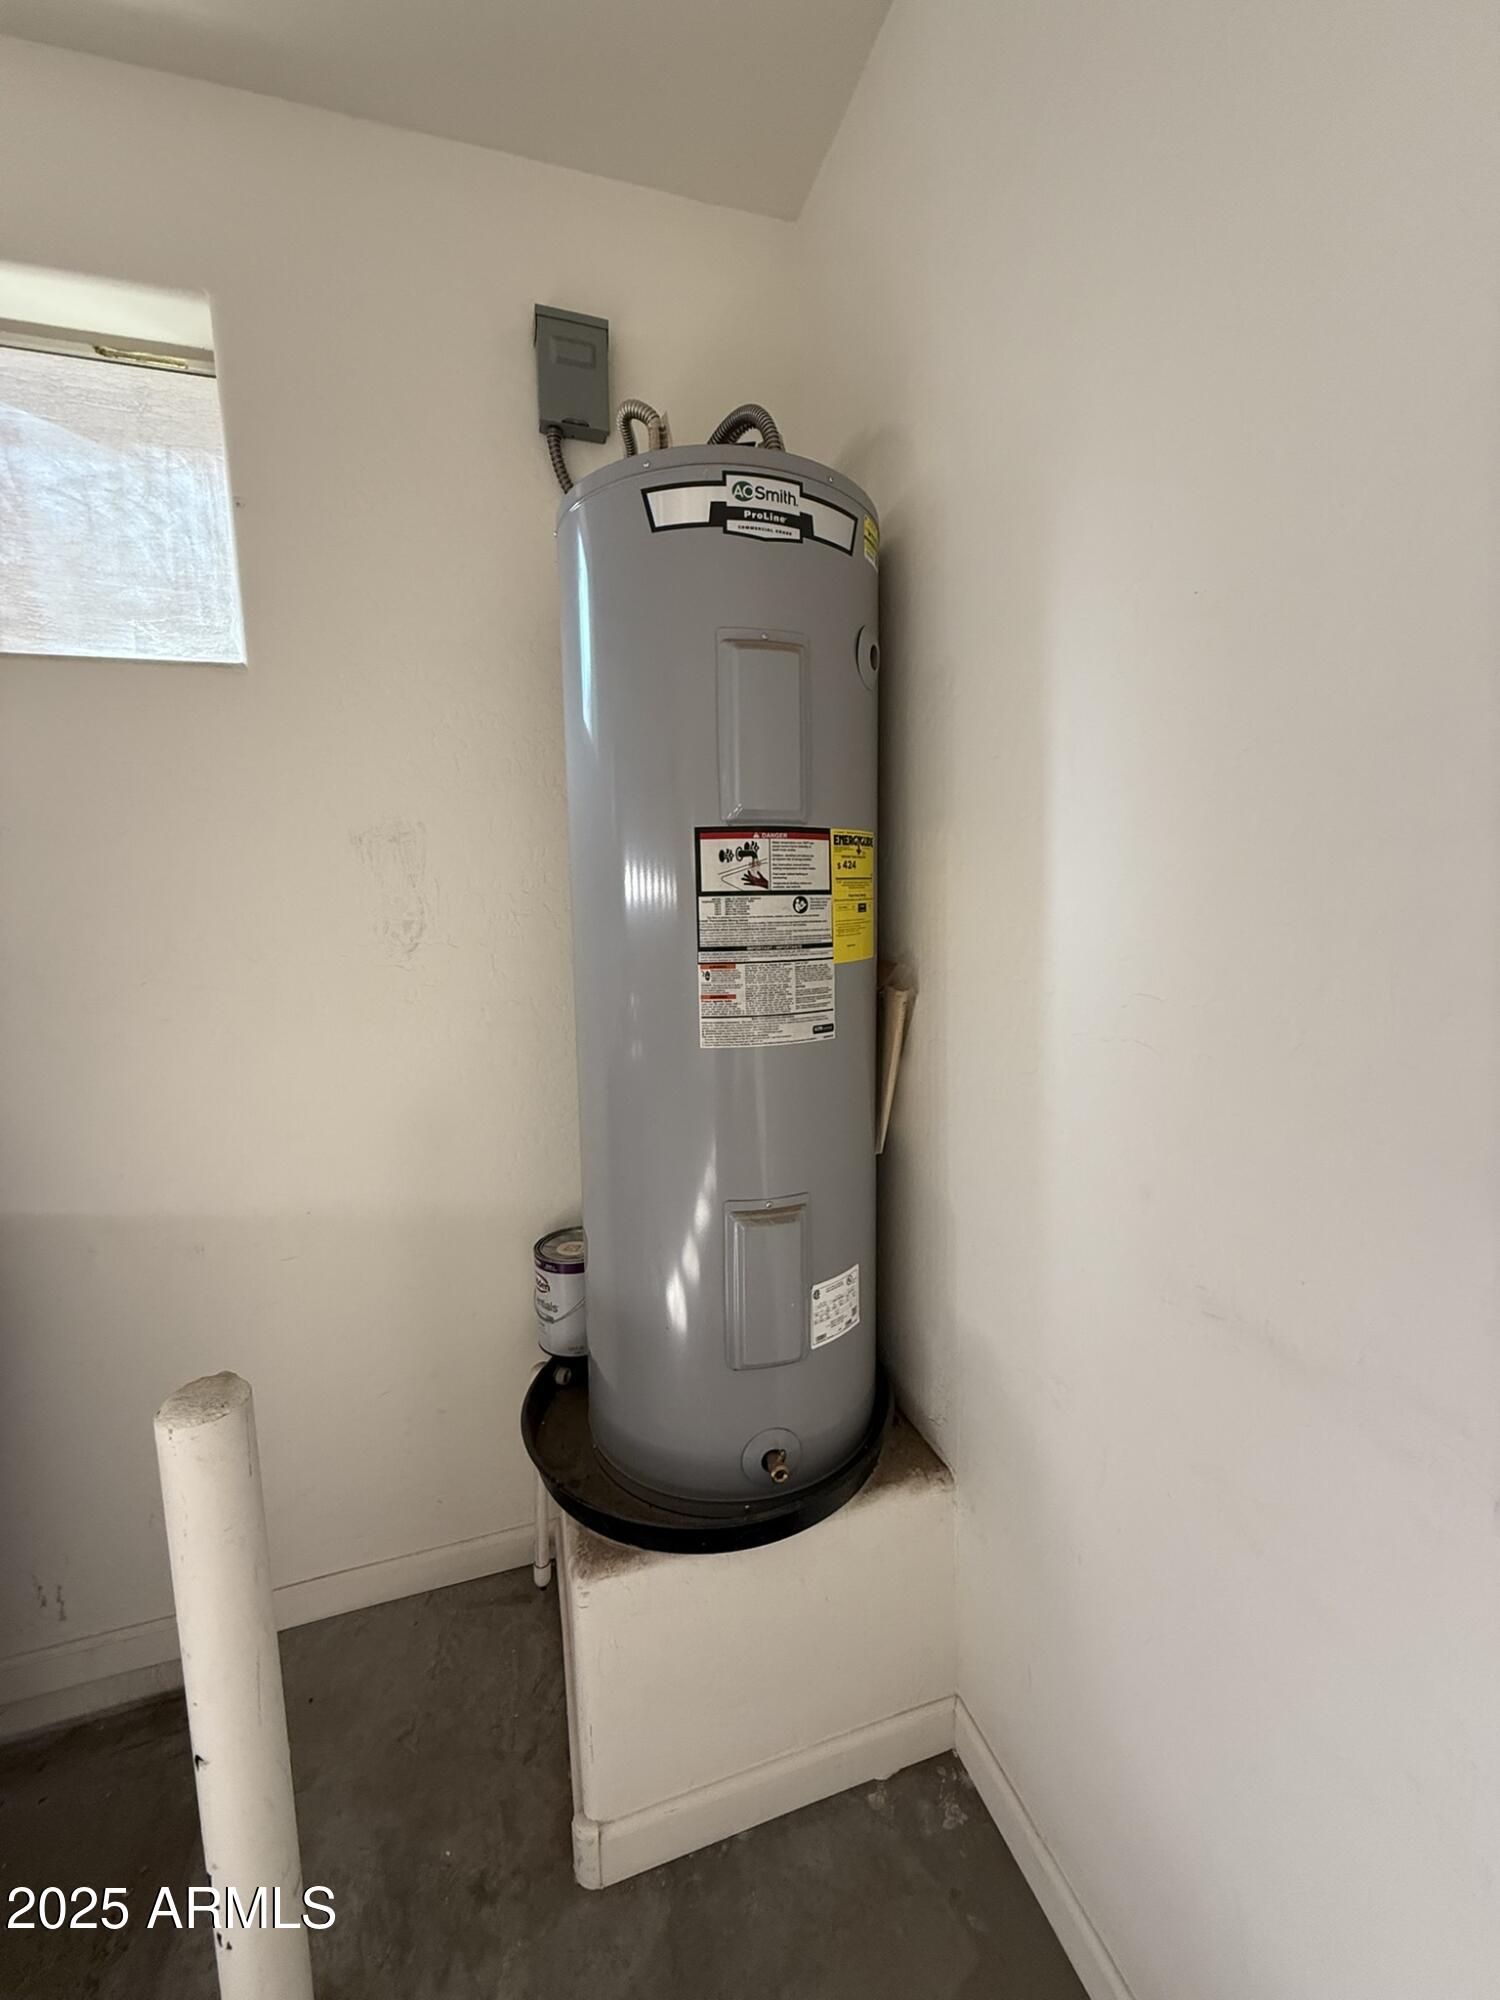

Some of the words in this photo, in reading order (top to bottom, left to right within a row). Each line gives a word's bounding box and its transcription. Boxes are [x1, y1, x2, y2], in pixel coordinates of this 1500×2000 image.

[754, 486, 798, 507] Smith
[743, 509, 787, 524] ProLine
[842, 860, 857, 869] 424
